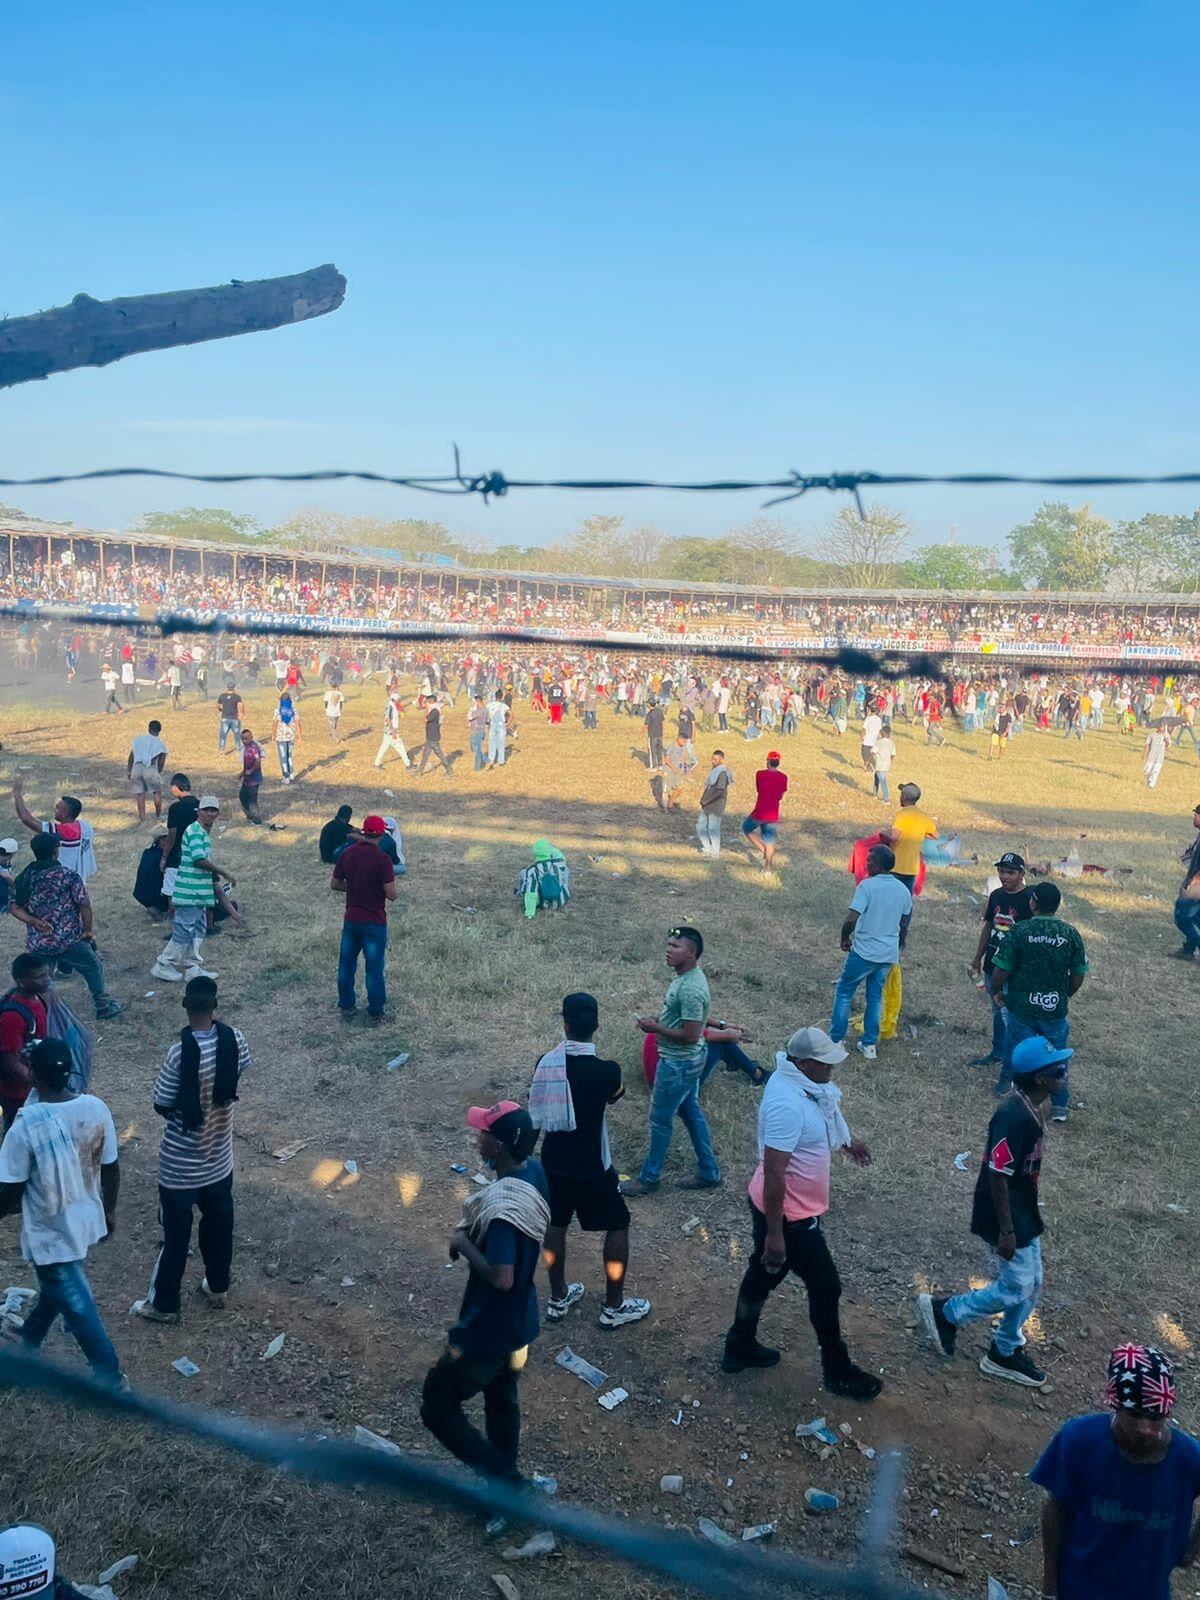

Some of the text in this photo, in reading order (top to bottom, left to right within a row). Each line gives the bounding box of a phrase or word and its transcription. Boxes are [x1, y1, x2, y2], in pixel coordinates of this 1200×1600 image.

[884, 640, 917, 650] LICORES
[1128, 647, 1157, 655] ANTONIO
[1028, 935, 1057, 946] BetPlay
